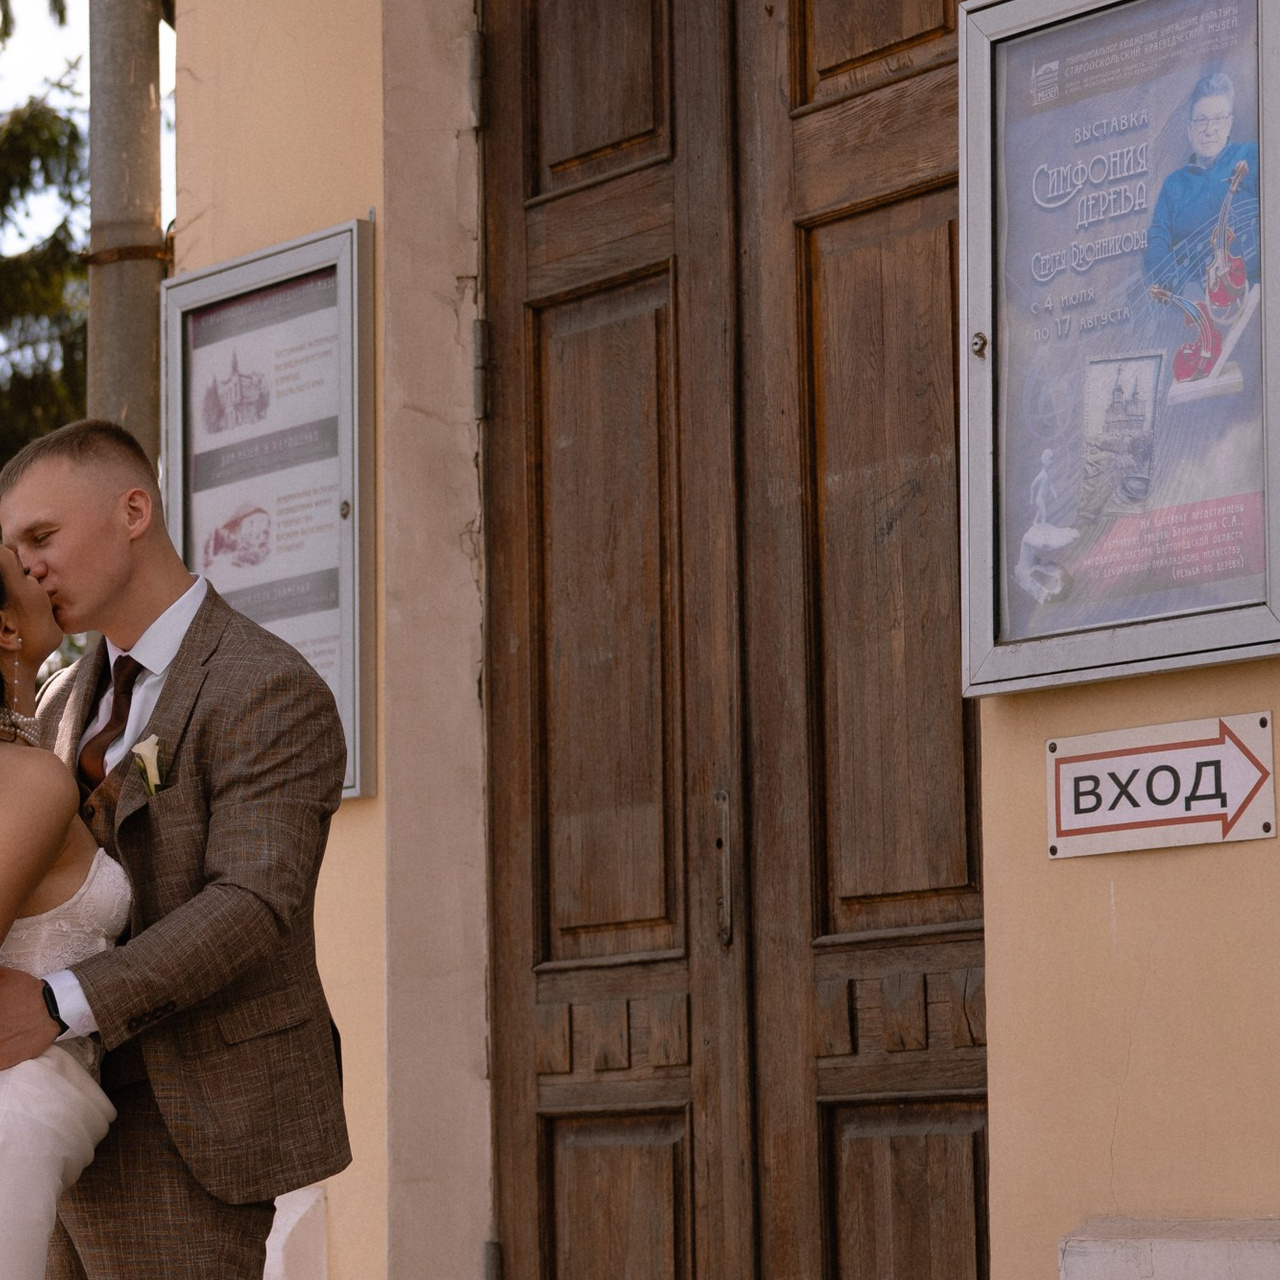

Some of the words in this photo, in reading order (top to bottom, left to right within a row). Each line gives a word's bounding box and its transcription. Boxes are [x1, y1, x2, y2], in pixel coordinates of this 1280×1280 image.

[1065, 45, 1141, 78] СТАРООСКОЛЬСКИЙ
[1144, 26, 1204, 55] КРАЕВЕДЧЕСКИЙ
[1208, 16, 1239, 34] МУЗЕЙ
[1120, 30, 1159, 52] БЮДЖЕТНОЕ
[1160, 15, 1200, 38] УЧРЕЖДЕНИЕ
[1200, 4, 1239, 25] КУЛЬТУРЫ
[1074, 109, 1149, 144] ВЫСТАВКА
[1076, 181, 1148, 230] ДЕРЕВА
[1044, 292, 1054, 311] 4
[1055, 314, 1071, 336] 17
[1073, 759, 1228, 815] ВХОД
